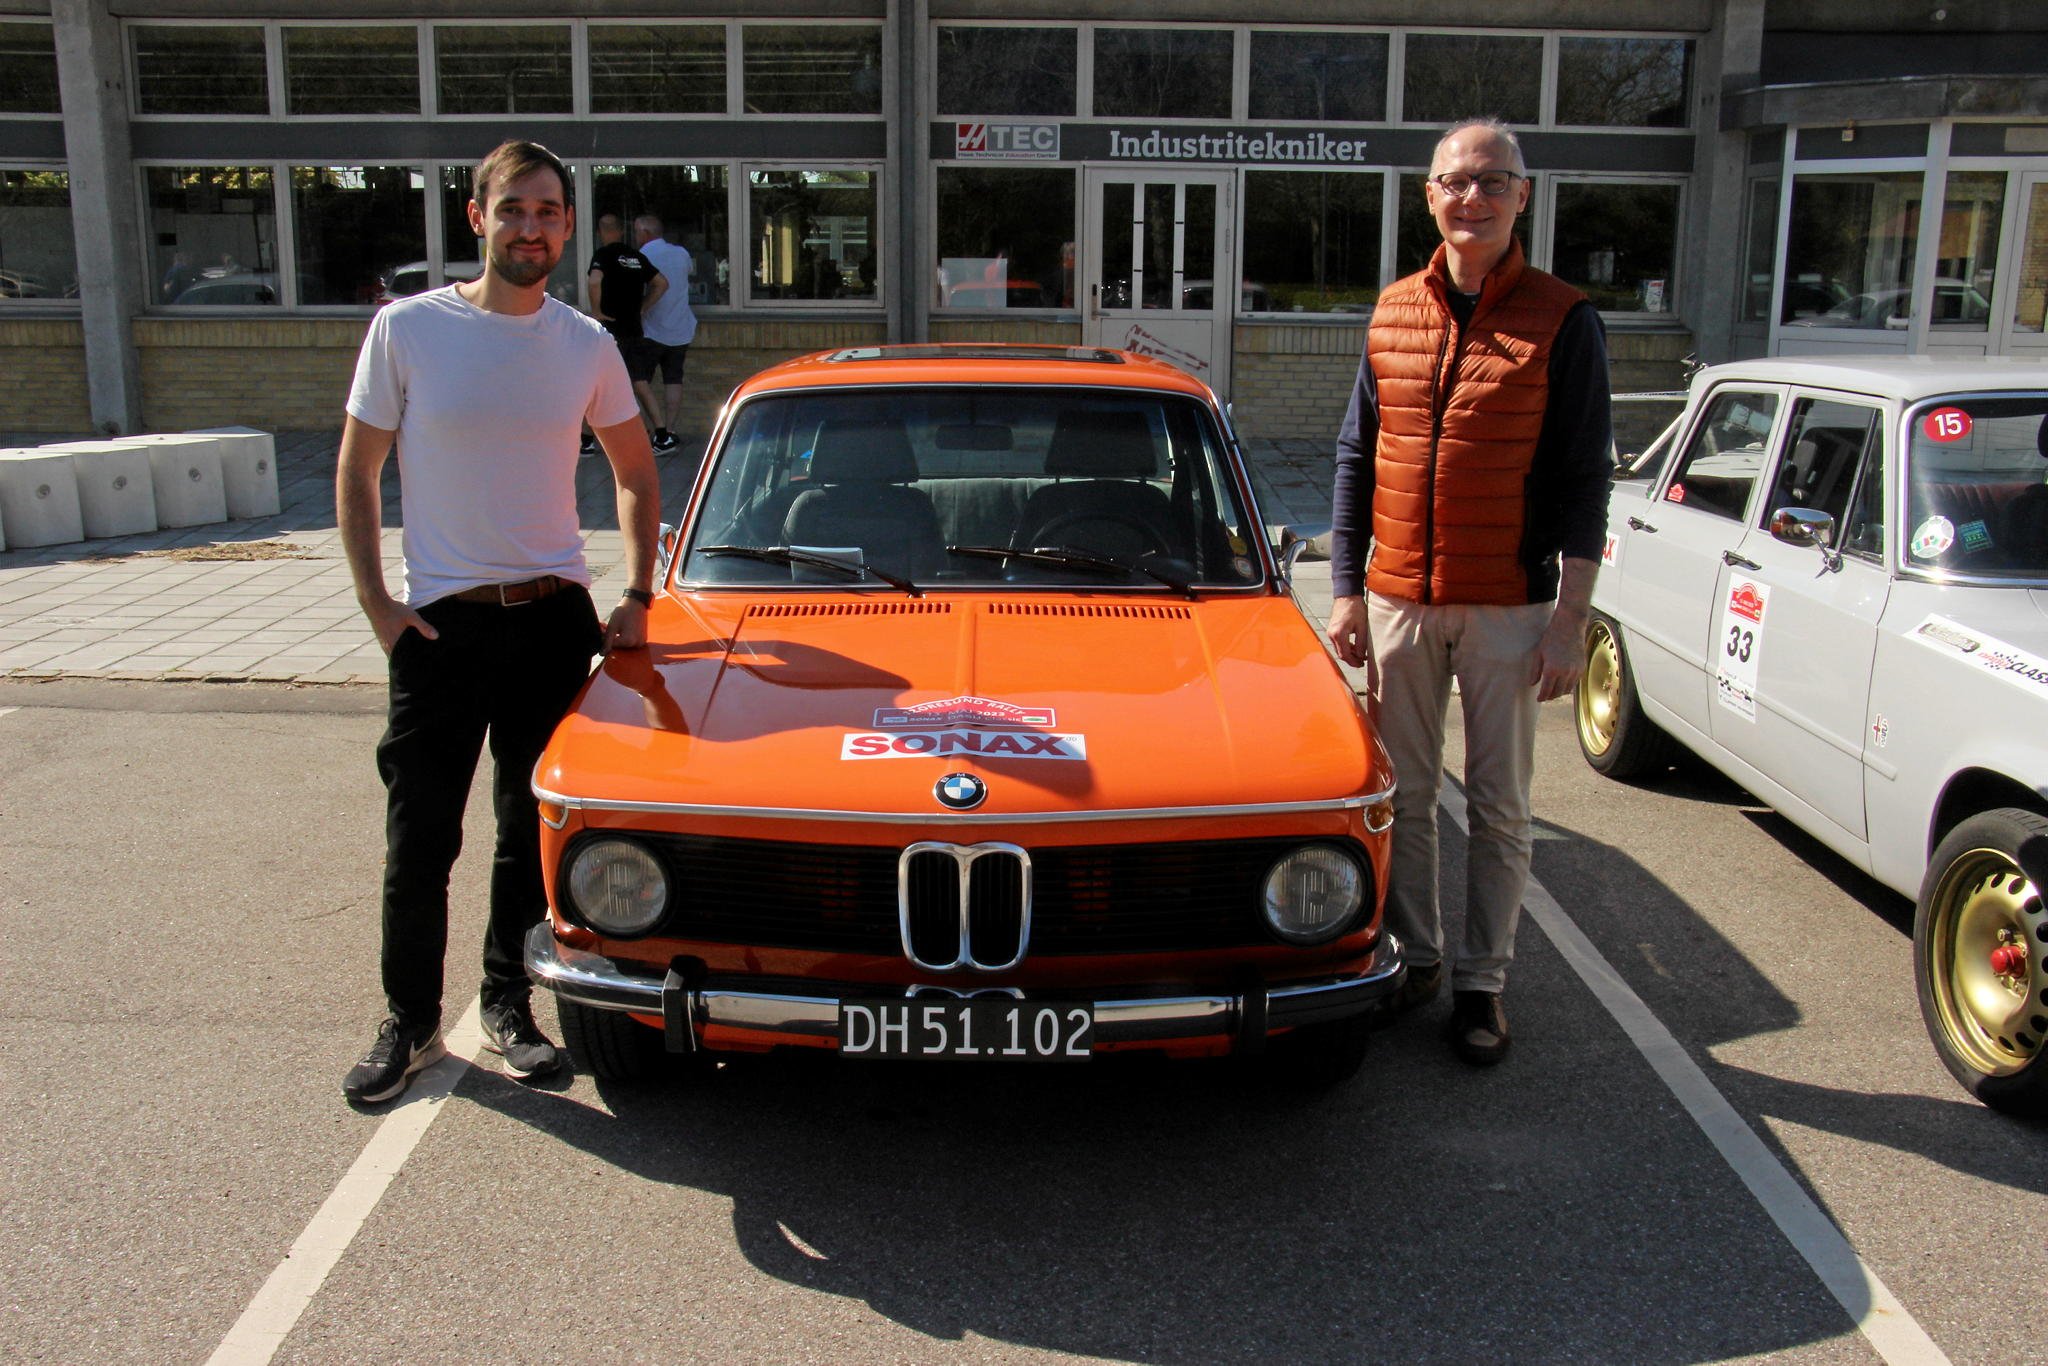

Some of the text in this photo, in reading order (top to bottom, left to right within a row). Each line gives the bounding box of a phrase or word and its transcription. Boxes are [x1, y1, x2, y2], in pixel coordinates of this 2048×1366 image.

[992, 126, 1054, 150] TEC
[1110, 130, 1367, 161] Industritekniker
[1934, 413, 1962, 437] 15
[1726, 625, 1754, 663] 33
[850, 733, 1069, 756] SONAX
[940, 773, 982, 785] BMW
[843, 1005, 1091, 1056] DH 51.102
